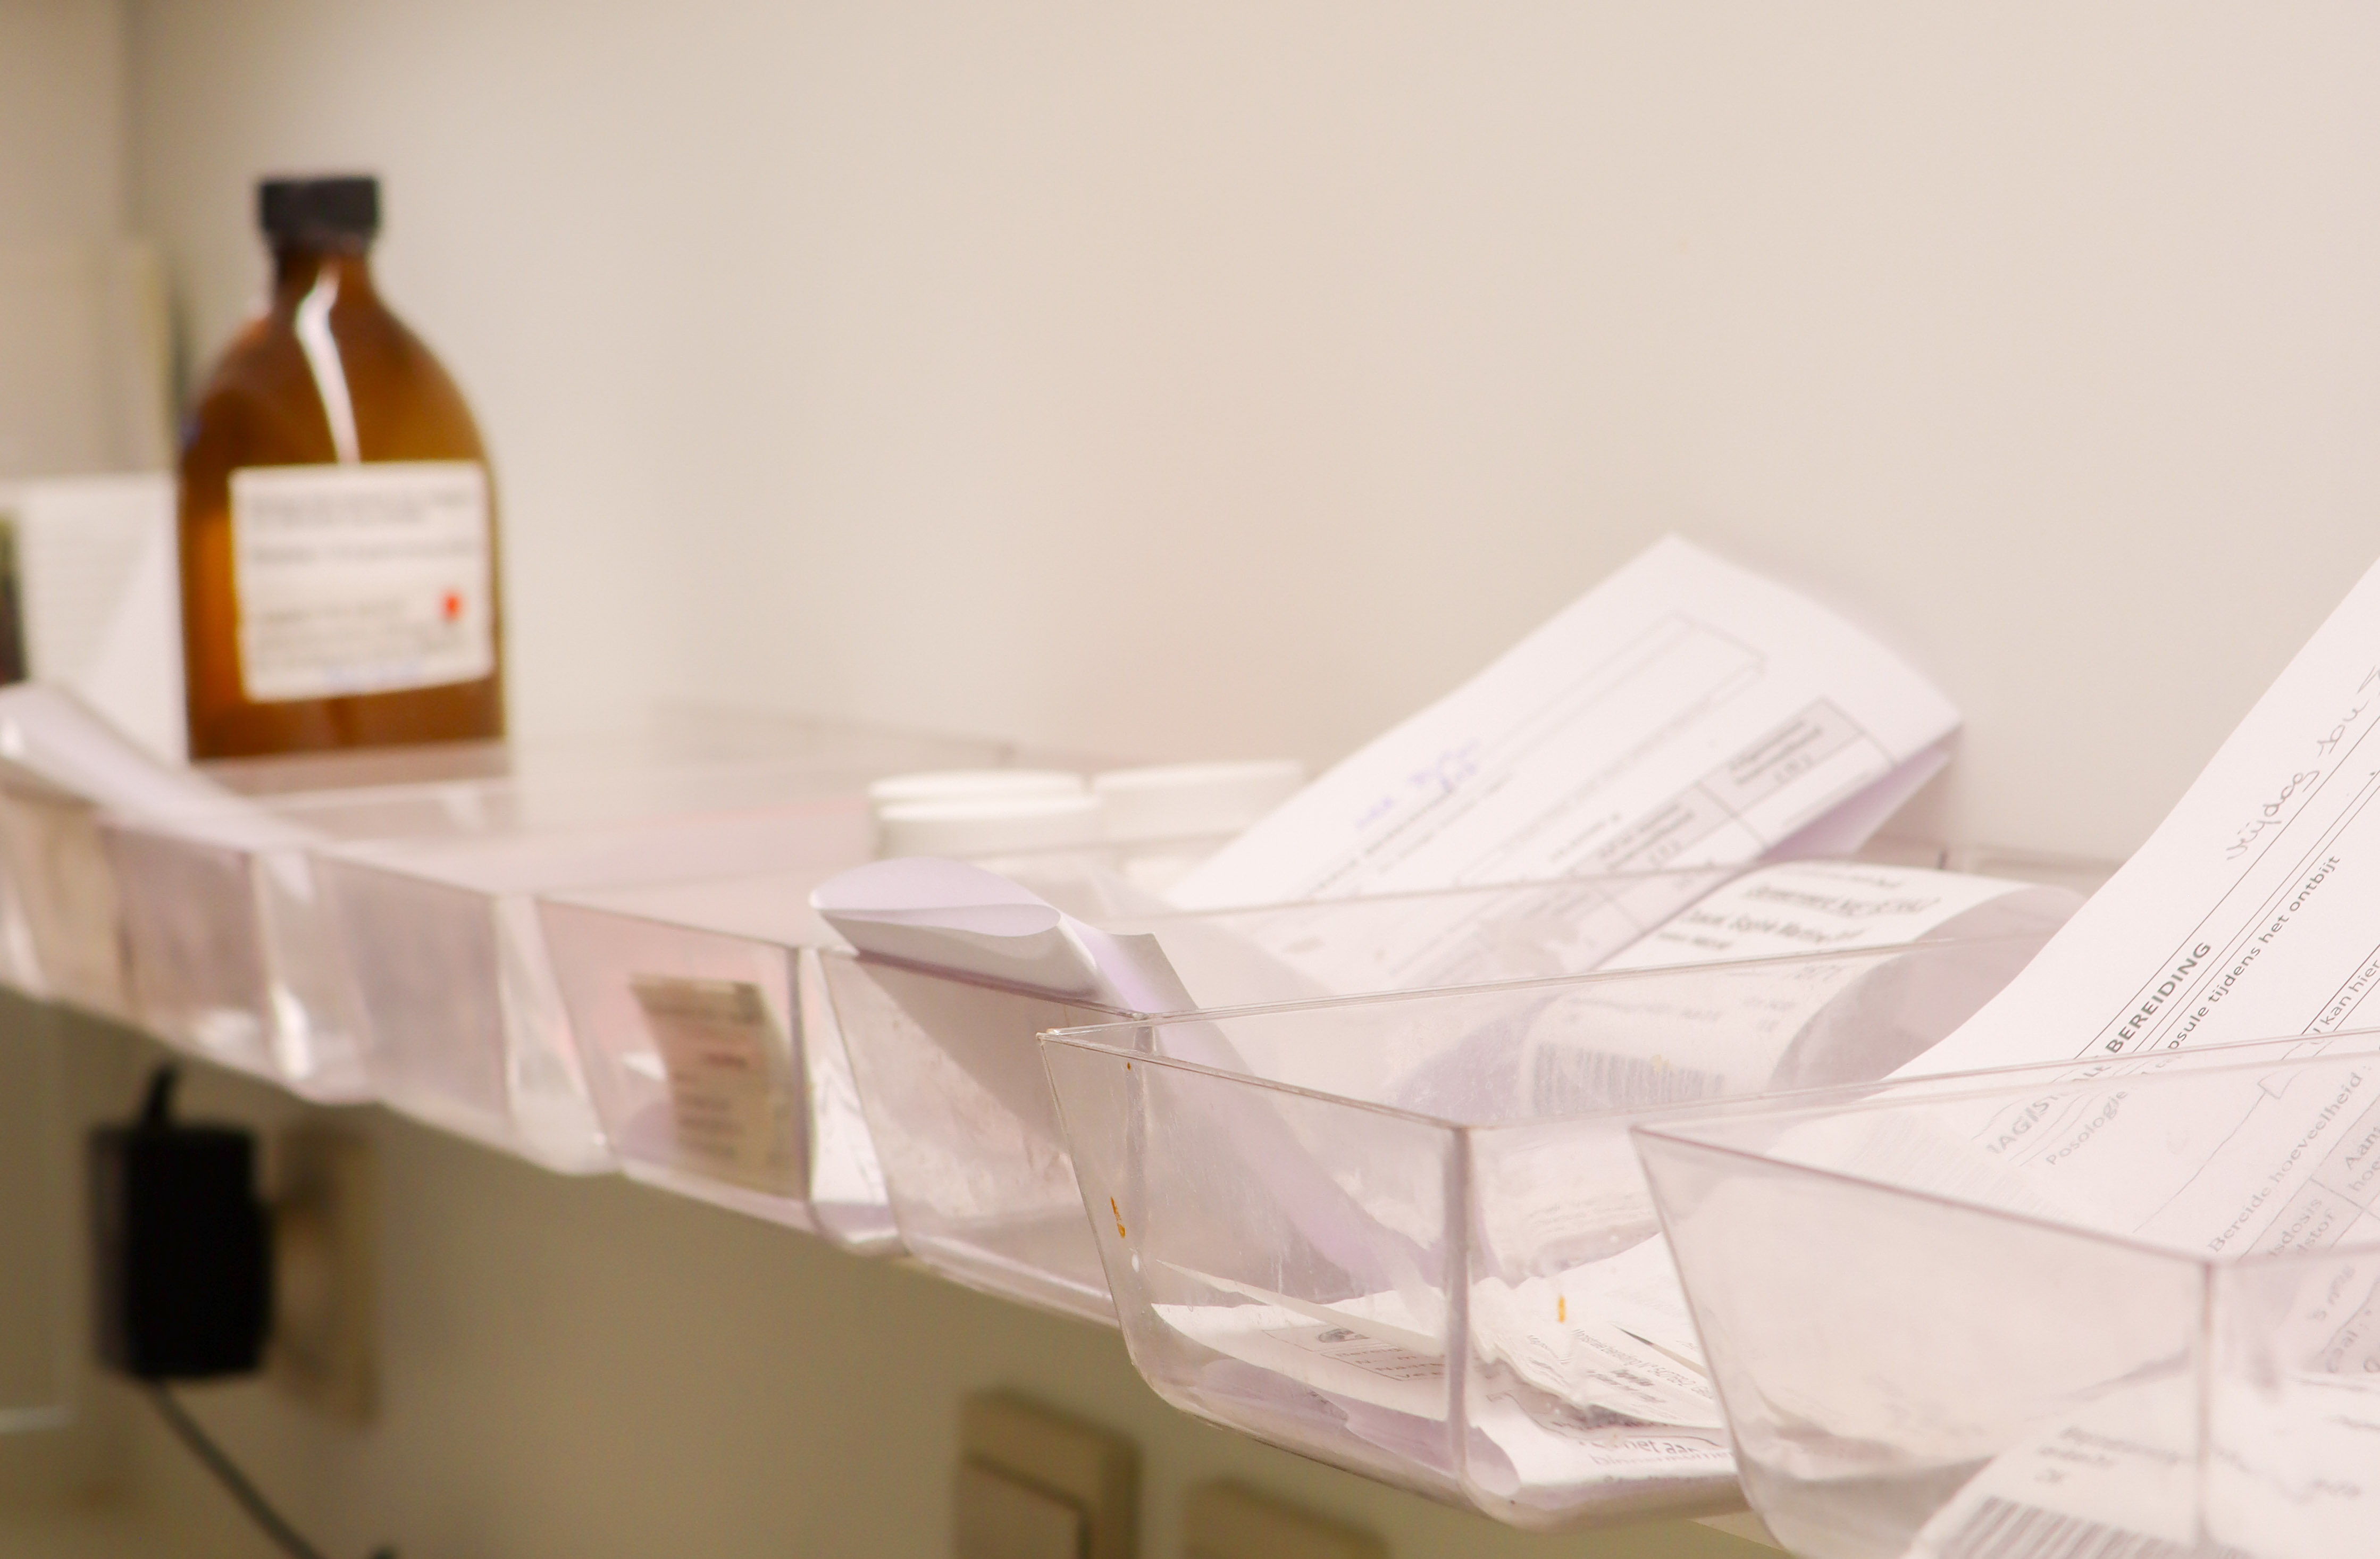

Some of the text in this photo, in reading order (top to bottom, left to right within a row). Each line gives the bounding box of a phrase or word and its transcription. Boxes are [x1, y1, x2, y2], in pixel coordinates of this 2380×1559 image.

[2208, 946, 2261, 1003] tijdens
[2258, 915, 2290, 944] het
[2289, 856, 2341, 912] ontbijt
[2105, 942, 2211, 1054] BEREIDING
[2320, 996, 2352, 1025] kan
[2349, 959, 2380, 993] hier
[2046, 1090, 2128, 1165] Posologie
[2208, 1187, 2272, 1253] Bereide
[2269, 1072, 2362, 1184] hoeveelheid
